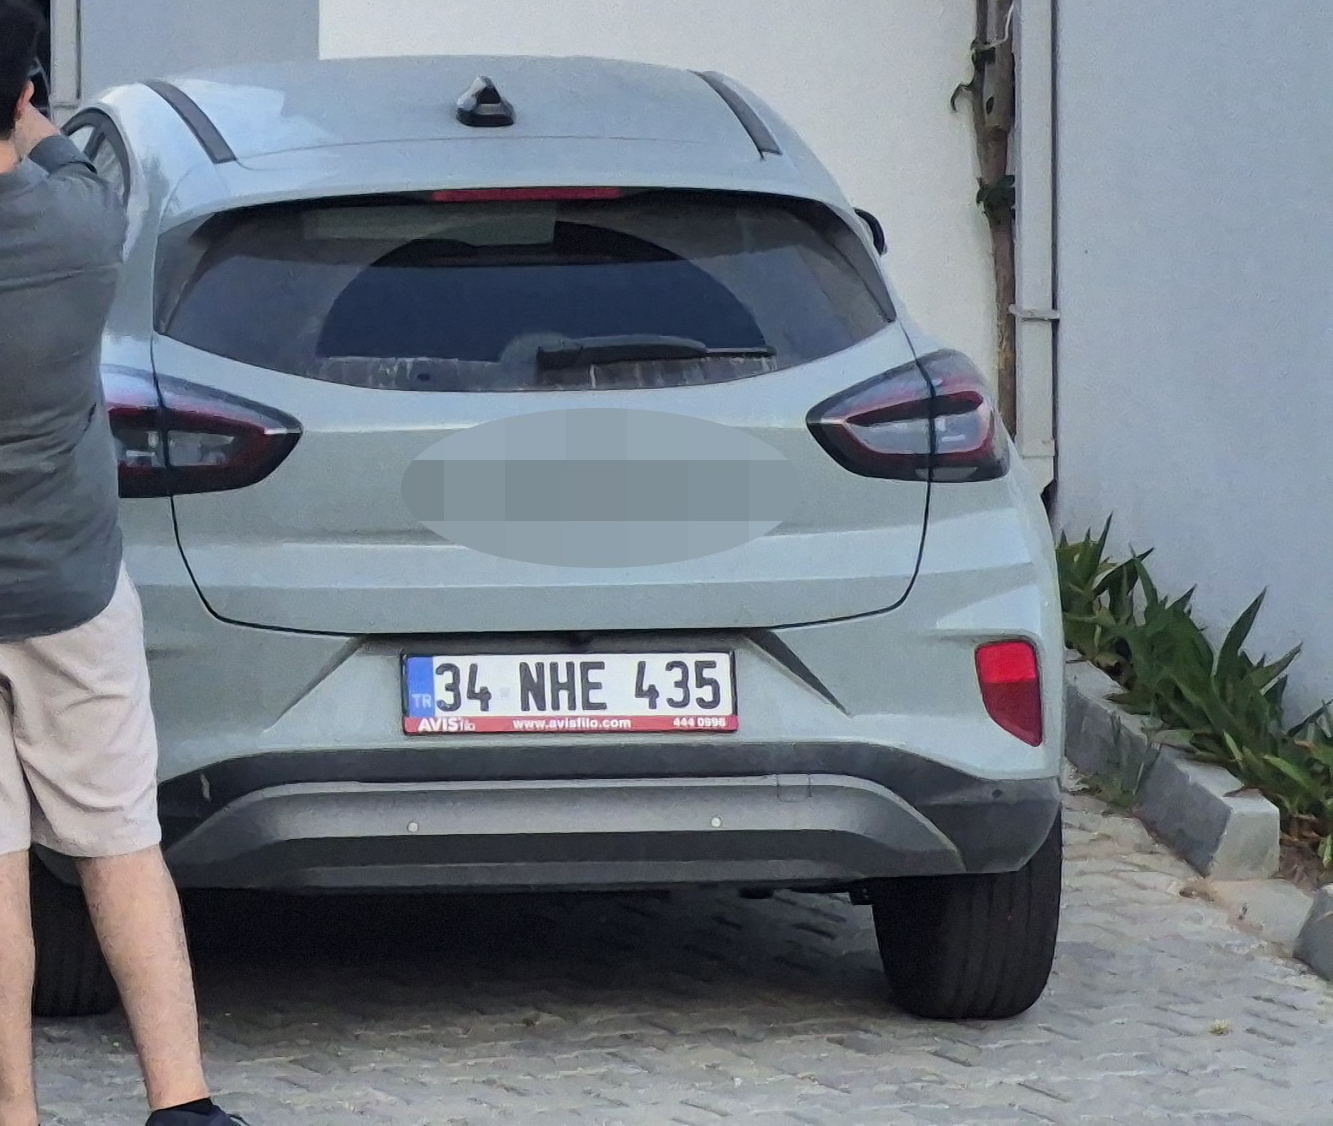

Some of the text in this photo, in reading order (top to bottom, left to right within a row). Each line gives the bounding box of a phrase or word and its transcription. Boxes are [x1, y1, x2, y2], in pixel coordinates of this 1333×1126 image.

[435, 660, 722, 712] 34 NHE 435
[412, 693, 432, 708] TR
[512, 717, 632, 730] www.avisfilo.com
